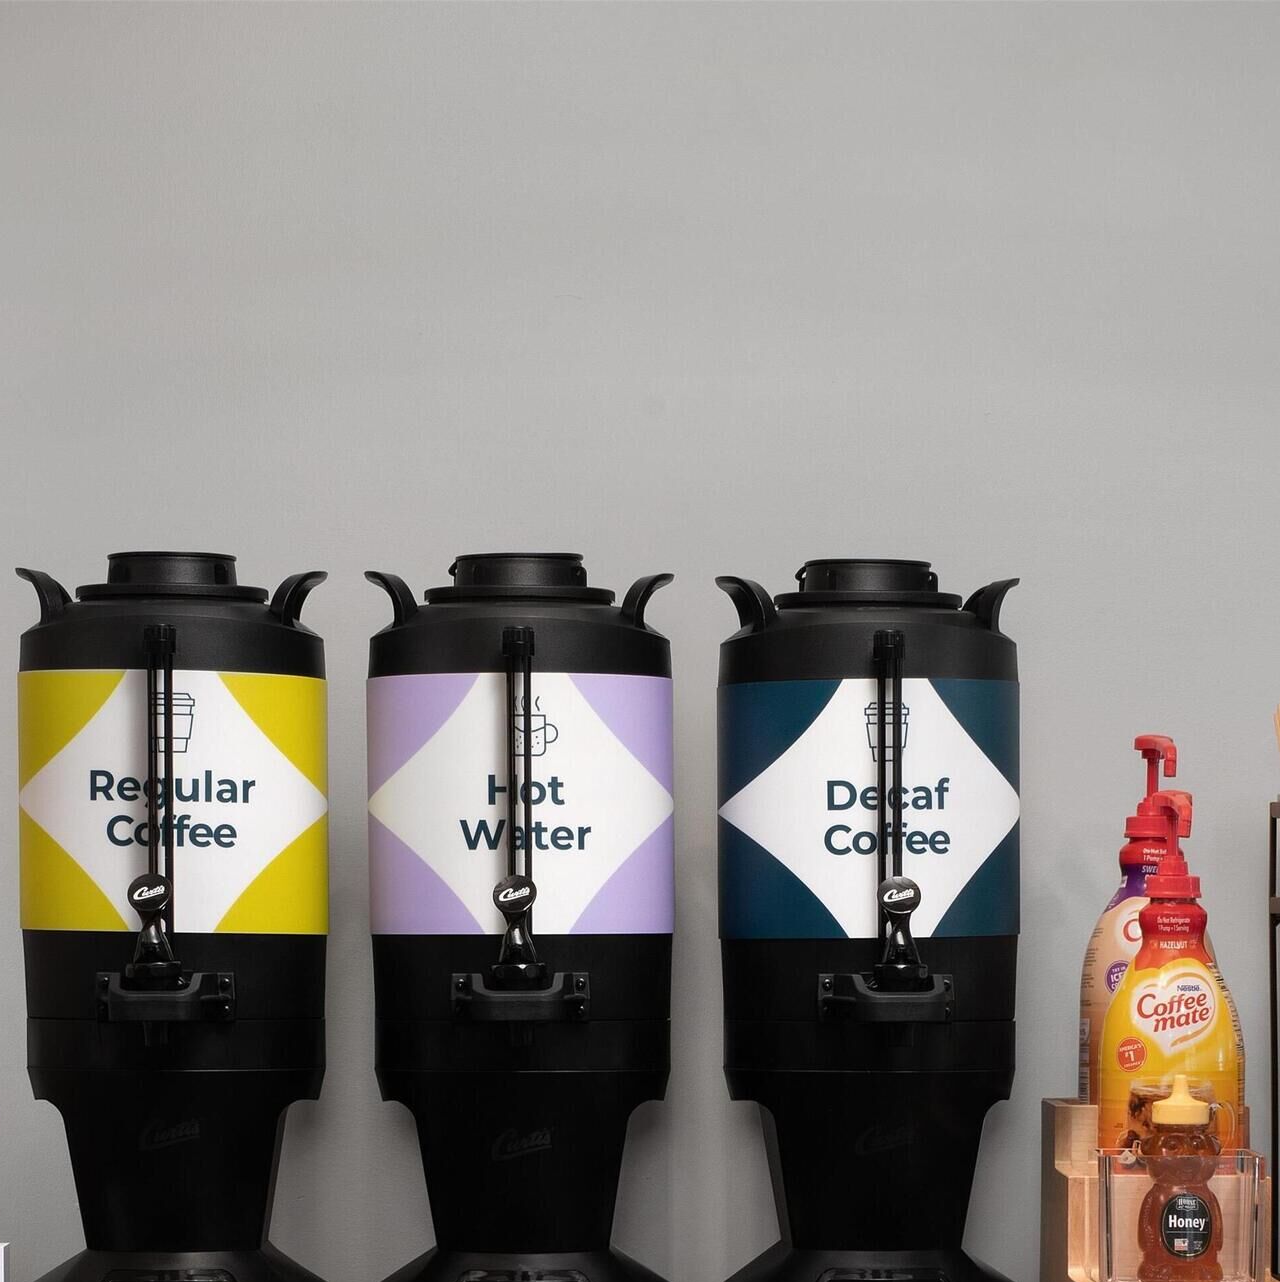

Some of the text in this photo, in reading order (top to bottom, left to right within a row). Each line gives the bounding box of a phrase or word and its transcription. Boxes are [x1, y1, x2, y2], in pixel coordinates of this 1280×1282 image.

[90, 769, 256, 810] Regular
[487, 774, 565, 806] Hot
[826, 777, 950, 811] Decaf
[106, 814, 238, 848] Coffee
[459, 819, 592, 850] Water
[1142, 865, 1158, 873] SWE
[1137, 993, 1208, 1019] Coffee
[1153, 1007, 1210, 1033] mate
[1168, 1214, 1205, 1231] Honey
